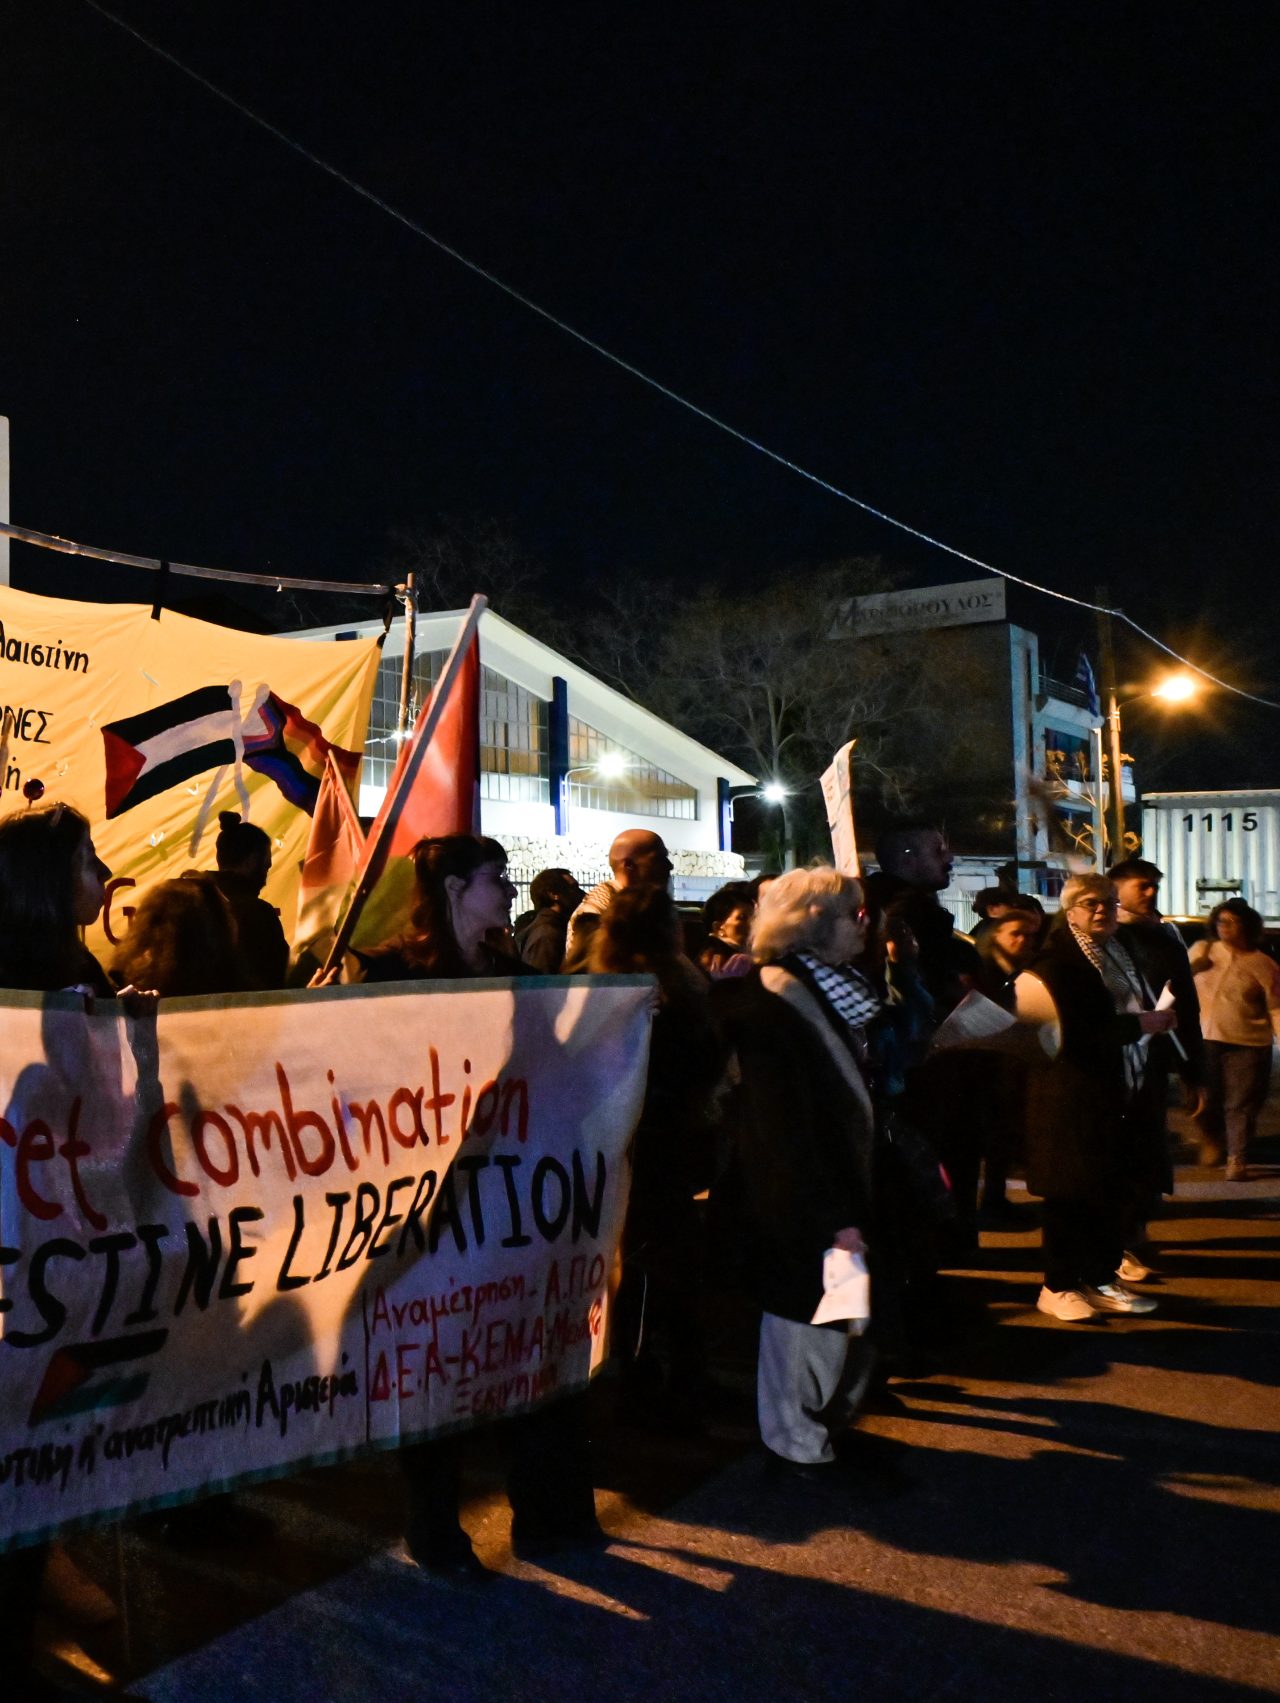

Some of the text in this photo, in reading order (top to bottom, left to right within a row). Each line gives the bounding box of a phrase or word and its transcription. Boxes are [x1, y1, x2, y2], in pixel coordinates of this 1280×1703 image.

[1183, 812, 1259, 833] 1115
[147, 1046, 530, 1198] combination
[276, 1148, 607, 1293] LIBERATION
